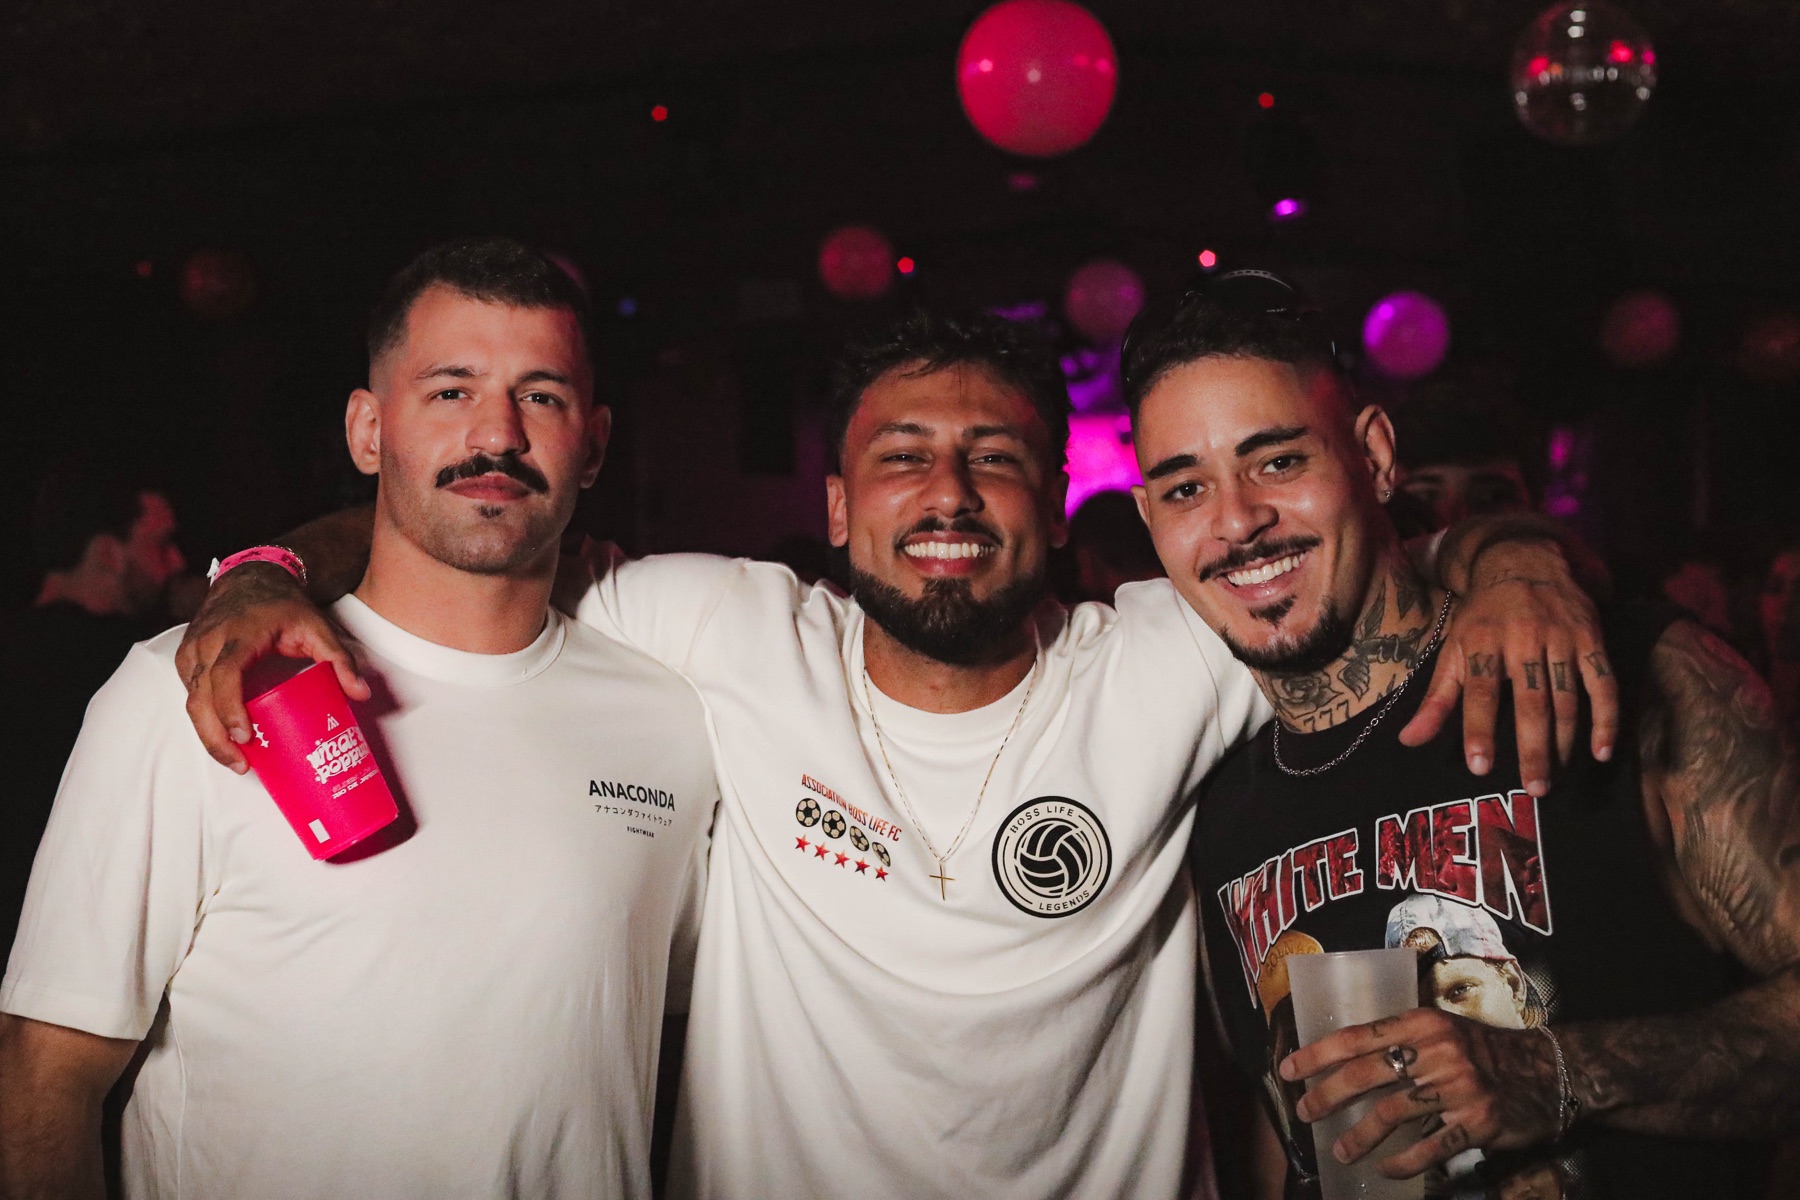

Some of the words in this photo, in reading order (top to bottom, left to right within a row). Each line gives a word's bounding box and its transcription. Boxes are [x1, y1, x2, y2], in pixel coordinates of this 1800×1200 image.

[1302, 699, 1351, 732] 777
[589, 779, 675, 812] ANACONDA
[801, 773, 847, 811] ASSOCIATION
[848, 803, 869, 826] BOSS
[868, 815, 889, 836] LIFE
[887, 824, 902, 842] FC
[626, 826, 655, 838] FIGHTWEAR
[1009, 808, 1040, 833] BOSS
[1046, 805, 1074, 817] LIFE
[1039, 889, 1090, 911] LEGENDS
[1217, 827, 1364, 1009] WHITE
[1376, 789, 1553, 936] MEN
